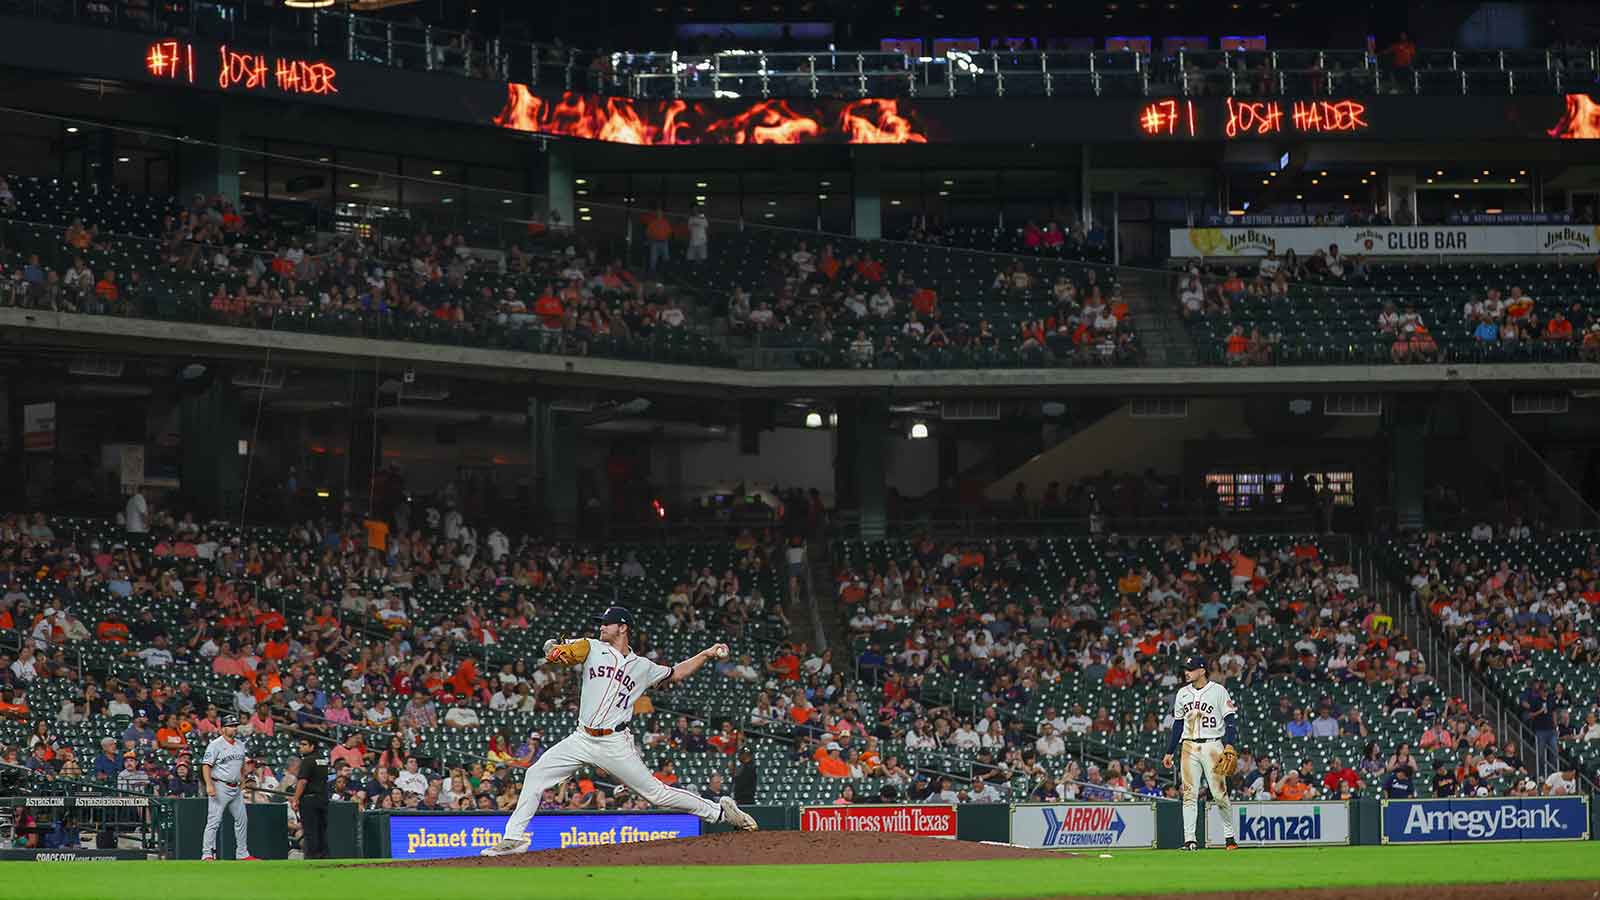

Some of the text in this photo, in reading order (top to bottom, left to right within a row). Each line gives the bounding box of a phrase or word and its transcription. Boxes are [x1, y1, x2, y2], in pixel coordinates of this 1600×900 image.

[218, 45, 268, 88] JOSH
[274, 57, 338, 94] HADER
[1226, 97, 1283, 137] JOSH
[1292, 99, 1368, 133] HADER
[1227, 233, 1247, 250] JIM
[1388, 231, 1467, 249] CLUB BAR
[1544, 233, 1562, 249] JIM
[1564, 227, 1590, 248] BEAM
[589, 665, 636, 692] ASTROS
[616, 692, 630, 710] 71
[1183, 701, 1214, 716] STROS
[1202, 716, 1217, 728] 29
[25, 798, 64, 807] ASTROS.COM
[808, 810, 949, 833] Don't mess with Texas
[1061, 808, 1115, 832] ARROW
[407, 826, 533, 853] planet fitns
[560, 826, 617, 849] planet
[1058, 833, 1113, 846] EXTERMINATORS
